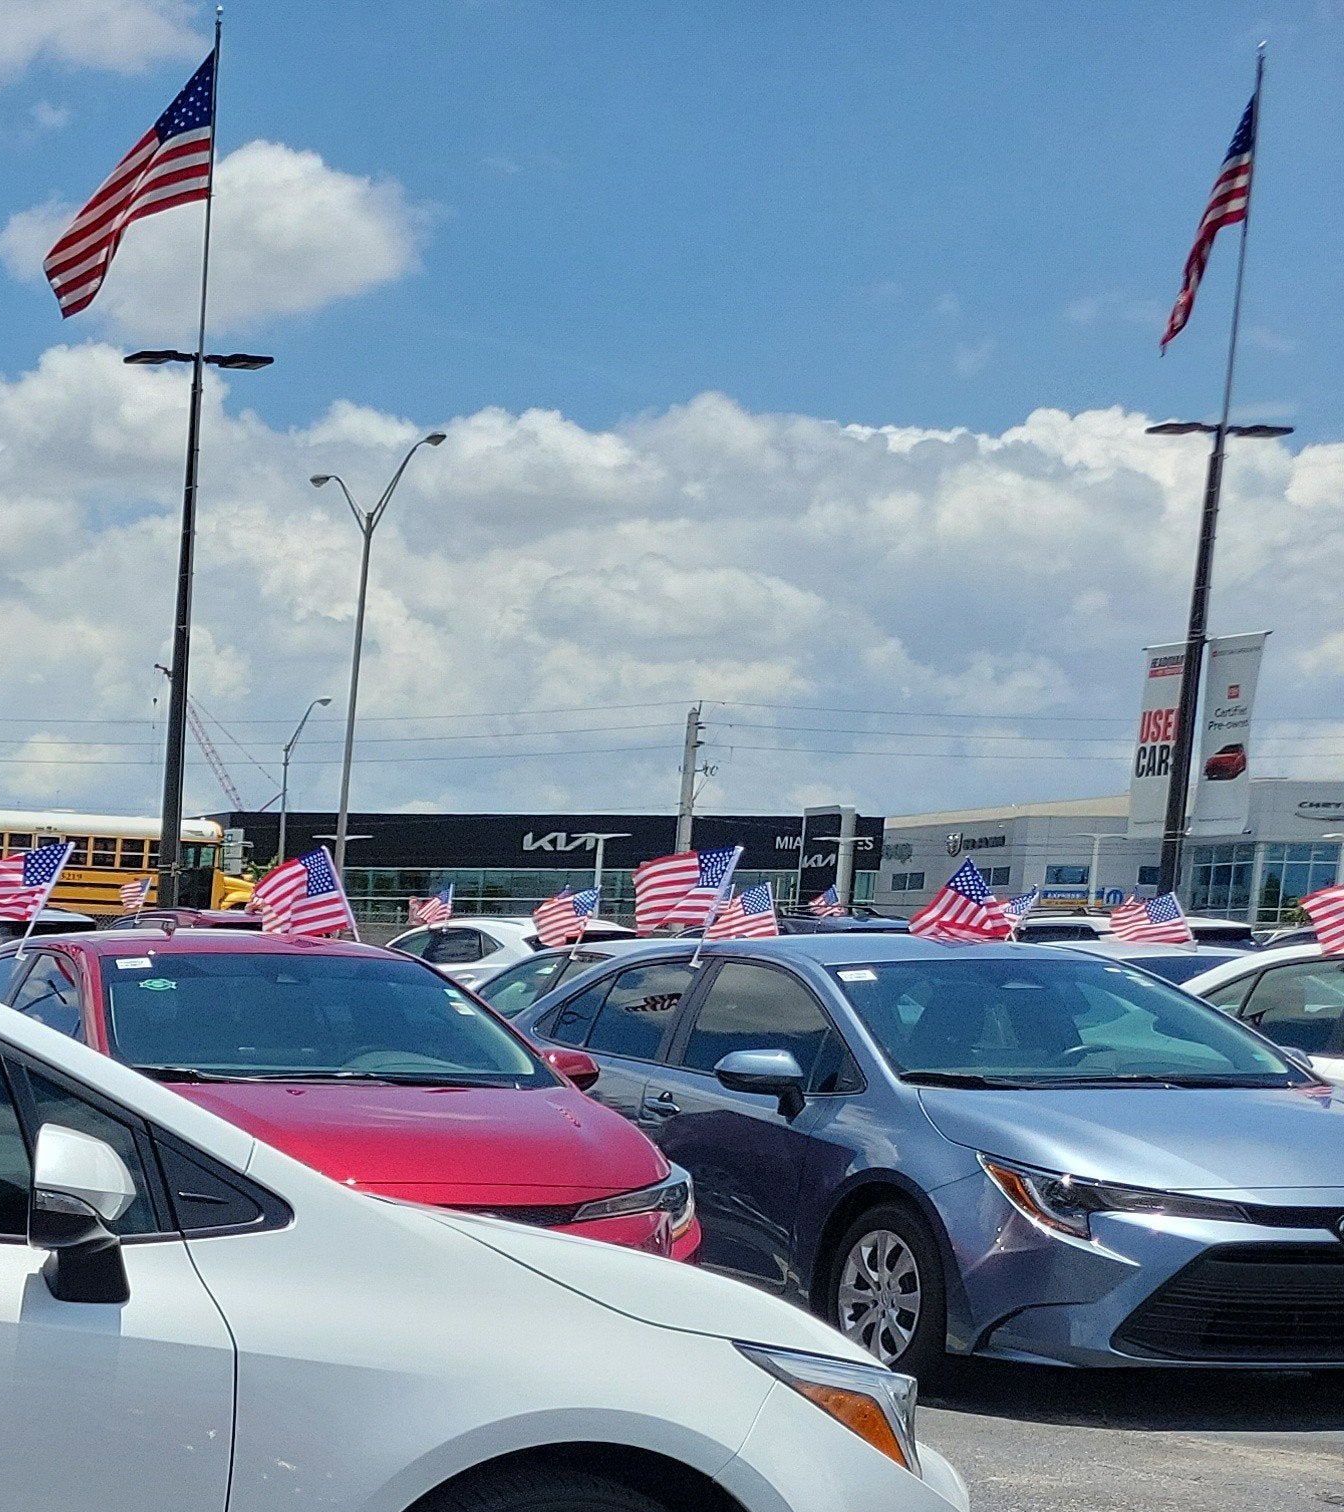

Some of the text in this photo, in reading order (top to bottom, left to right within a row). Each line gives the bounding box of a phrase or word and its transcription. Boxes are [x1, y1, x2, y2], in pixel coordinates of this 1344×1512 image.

[1135, 744, 1172, 778] CAR
[523, 832, 596, 851] KIA
[802, 854, 836, 868] KIA
